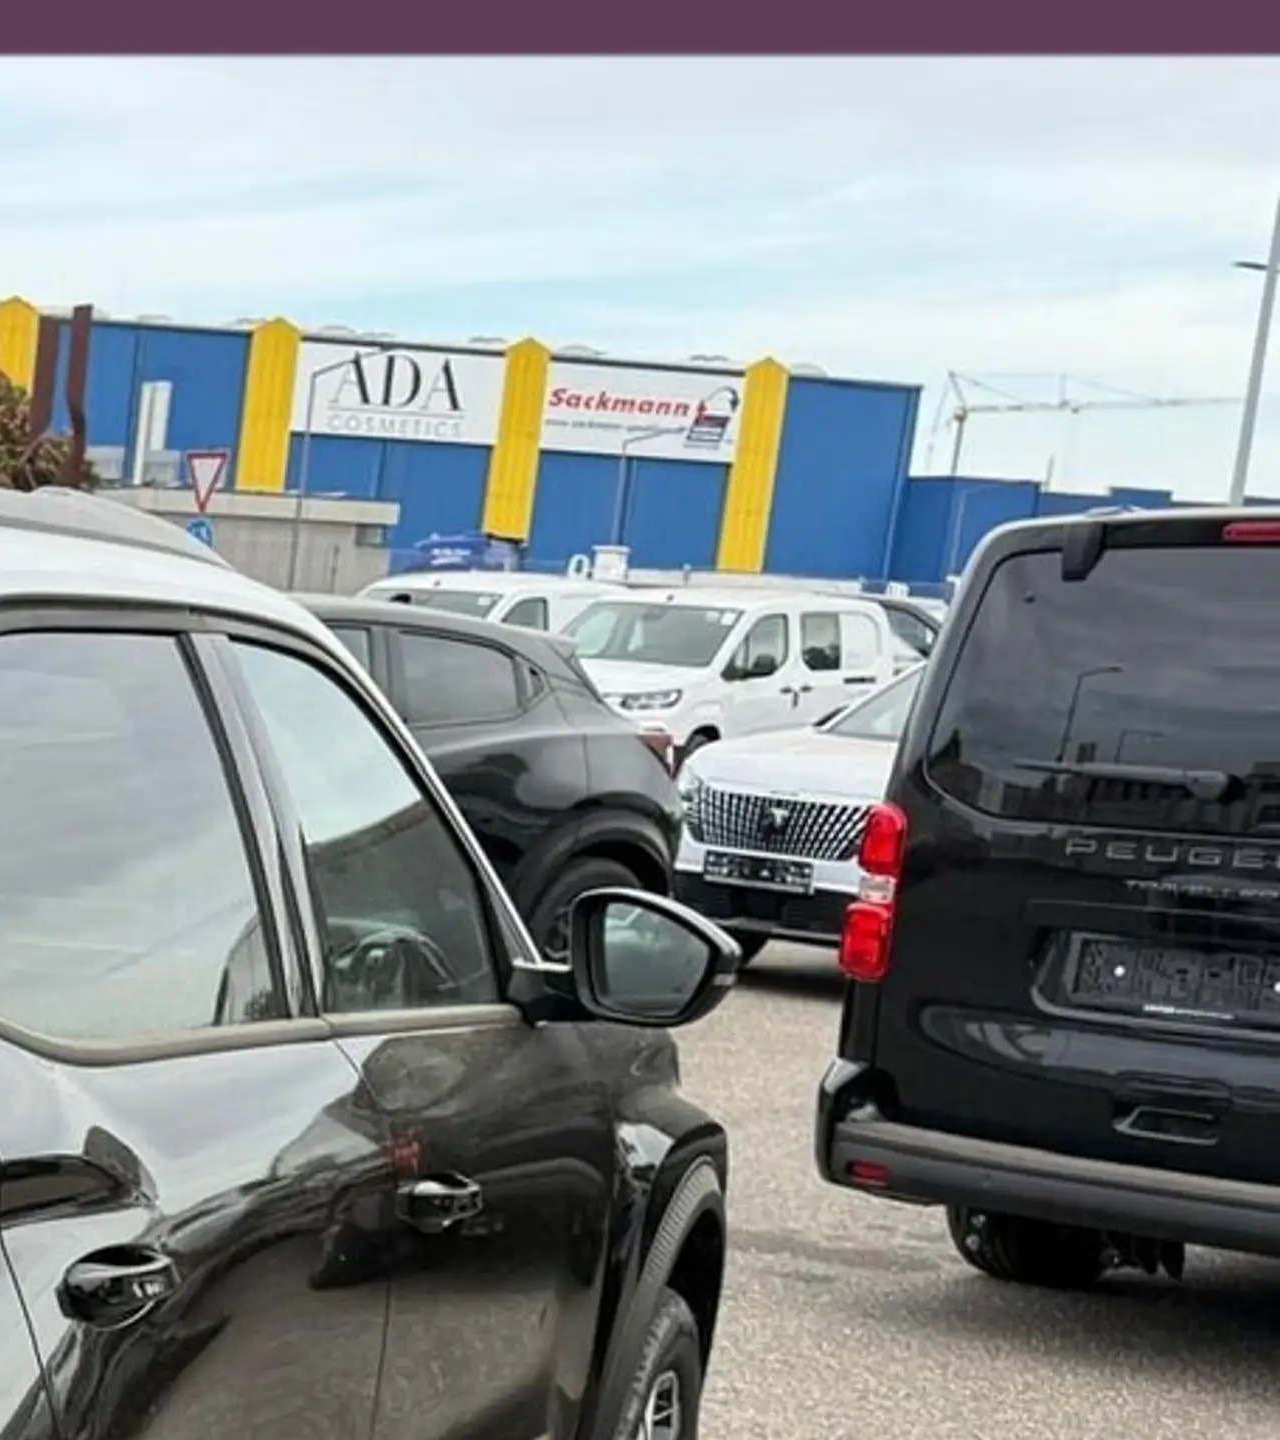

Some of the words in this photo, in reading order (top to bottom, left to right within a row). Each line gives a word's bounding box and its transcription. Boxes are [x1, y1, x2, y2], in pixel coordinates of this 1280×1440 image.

[327, 351, 464, 412] ADA
[548, 386, 690, 418] Sackmann
[326, 413, 462, 438] COSMETICS
[1064, 837, 1280, 869] PEUGE
